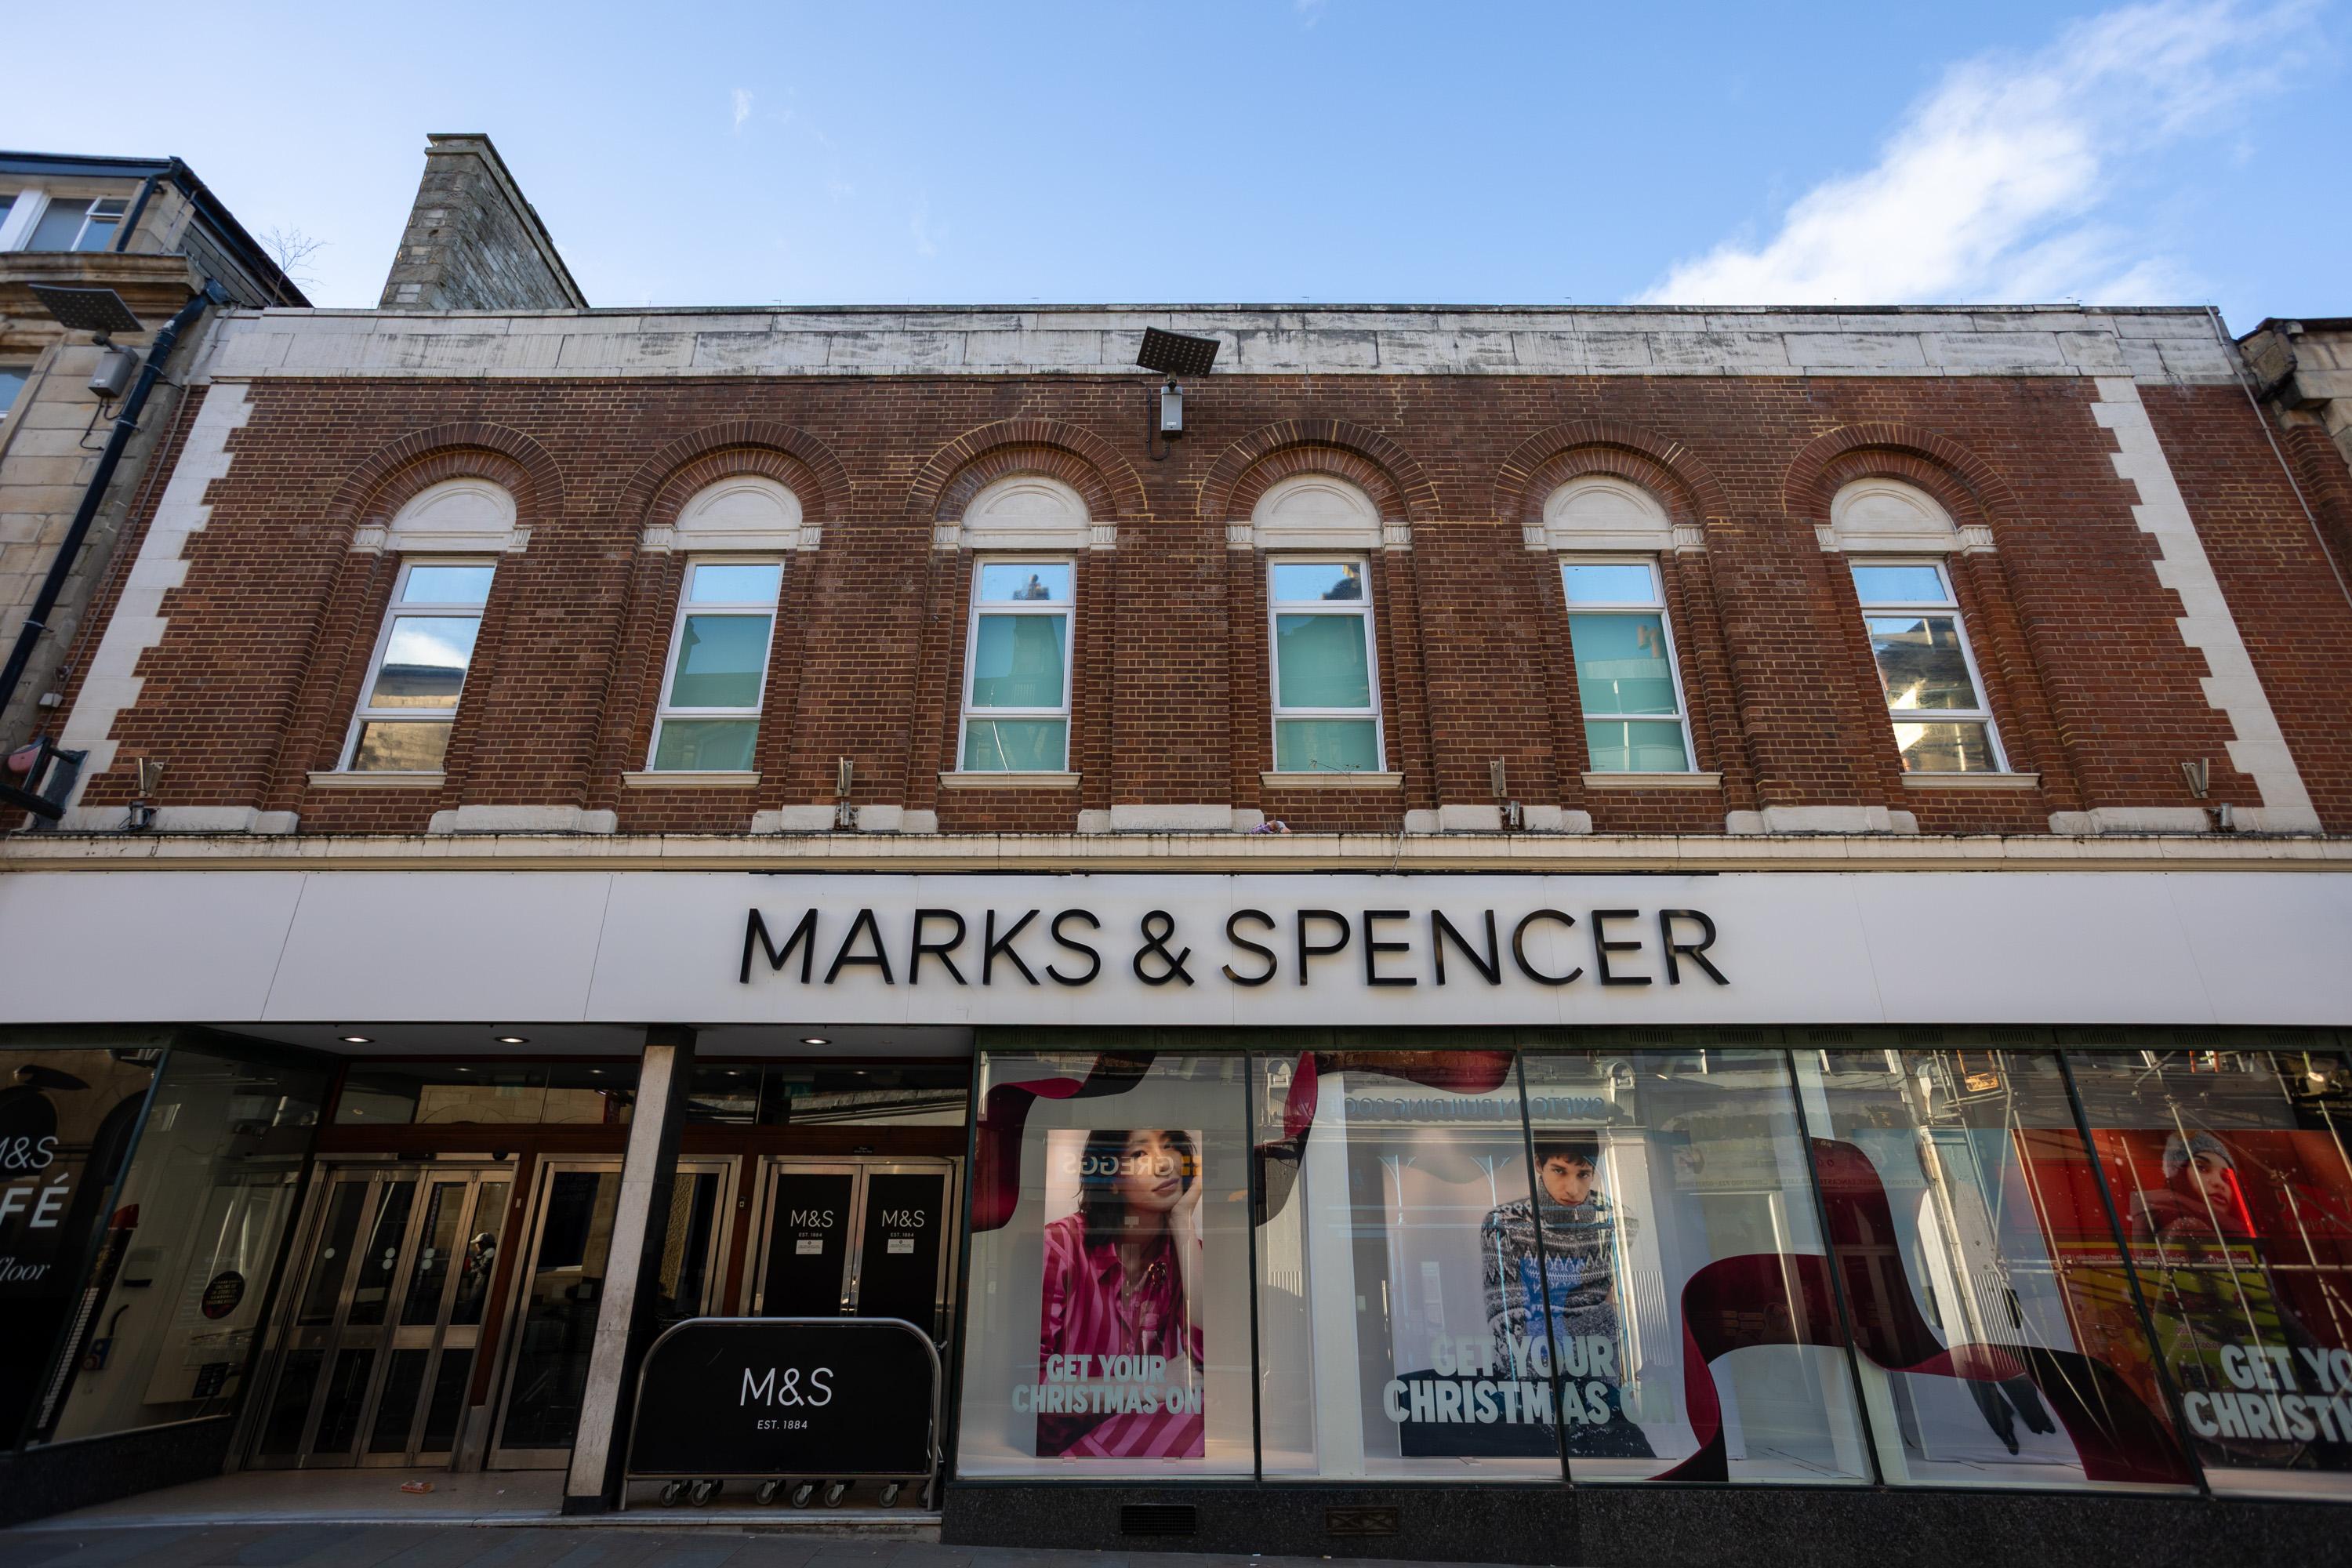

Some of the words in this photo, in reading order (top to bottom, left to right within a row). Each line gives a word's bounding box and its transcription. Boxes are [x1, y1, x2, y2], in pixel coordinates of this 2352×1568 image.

[740, 909, 1100, 986] MARKS
[1134, 910, 1194, 986] &
[1222, 909, 1730, 986] SPENCER
[0, 1136, 59, 1169] &S
[790, 1210, 834, 1228] M&S
[881, 1210, 925, 1228] M&S
[1046, 1354, 1092, 1382] GET
[1098, 1354, 1167, 1383] YOUR
[1431, 1334, 1495, 1377] GET
[1511, 1334, 1617, 1377] YOUR
[2220, 1345, 2297, 1391] GET
[740, 1367, 834, 1406] M&S
[1011, 1385, 1160, 1414] CHRISTMAS
[1166, 1385, 1203, 1414] ON
[757, 1420, 780, 1429] EST.
[783, 1420, 808, 1429] 1884
